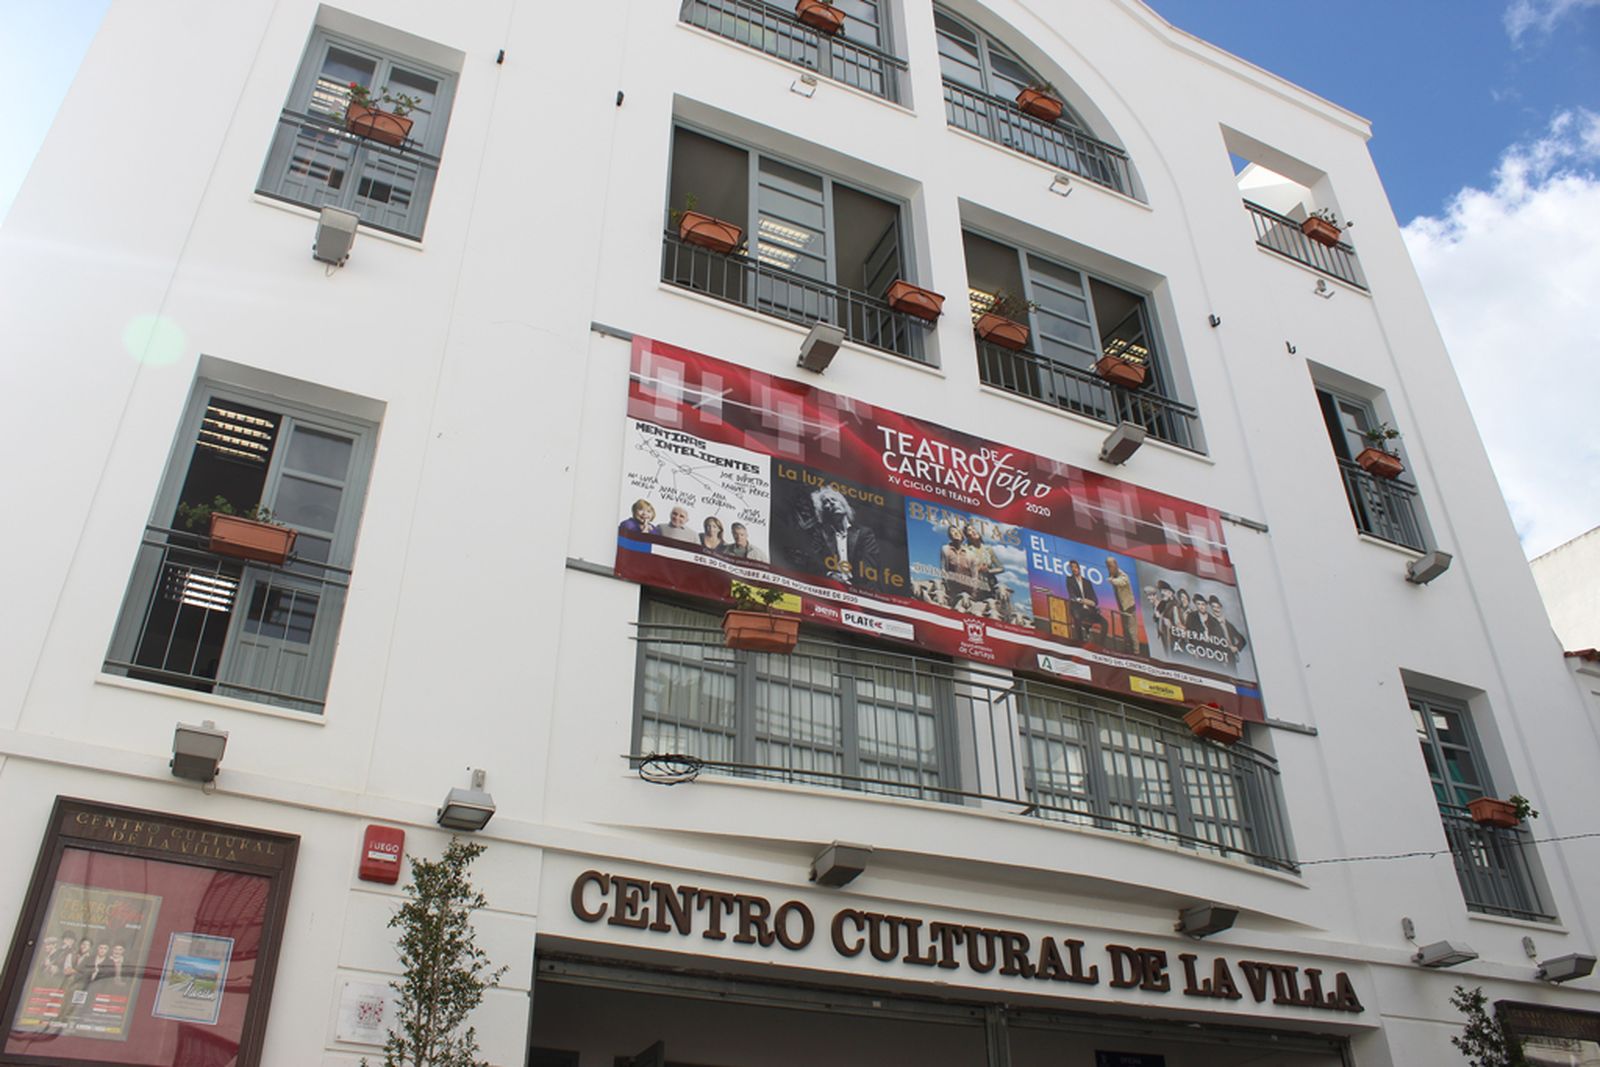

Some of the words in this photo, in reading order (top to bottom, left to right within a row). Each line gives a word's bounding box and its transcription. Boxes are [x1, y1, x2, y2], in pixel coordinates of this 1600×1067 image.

[635, 421, 707, 450] MENTIRAS
[877, 425, 988, 477] TEATRO
[980, 447, 999, 462] DE
[654, 438, 760, 475] INTELIGENTES
[777, 464, 798, 481] La
[802, 470, 826, 489] luz
[830, 481, 885, 507] oscura
[882, 451, 984, 497] CARTAYA
[888, 474, 900, 485] XV
[902, 479, 933, 494] CICLO
[935, 487, 947, 497] DE
[948, 490, 981, 507] TEATRO
[909, 501, 1022, 546] BENDITAS
[1025, 502, 1051, 517] 2020
[1030, 535, 1049, 553] EL
[694, 555, 708, 565] DEL
[708, 558, 718, 568] 30
[728, 565, 760, 579] OCTUBRE
[762, 573, 771, 581] AL
[772, 576, 781, 584] 27
[791, 582, 831, 598] NOVIEMBRE
[824, 554, 853, 574] de
[859, 560, 879, 582] la
[883, 567, 905, 588] fe
[1032, 552, 1103, 586] ELECTO
[968, 648, 996, 660] Cartaya
[1171, 626, 1230, 648] ESPERANDO
[1173, 641, 1184, 653] A
[1185, 645, 1230, 663] GODOT
[75, 811, 161, 835] CENTRO
[170, 827, 275, 856] CULTURAL
[111, 830, 138, 843] DE
[147, 837, 170, 850] LA
[180, 841, 238, 862] VILLA
[571, 870, 815, 951] CENTRO
[831, 908, 1099, 985] CULTURAL
[1106, 944, 1171, 993] DE
[1179, 953, 1243, 1000] LA
[1238, 961, 1364, 1014] VILLA
